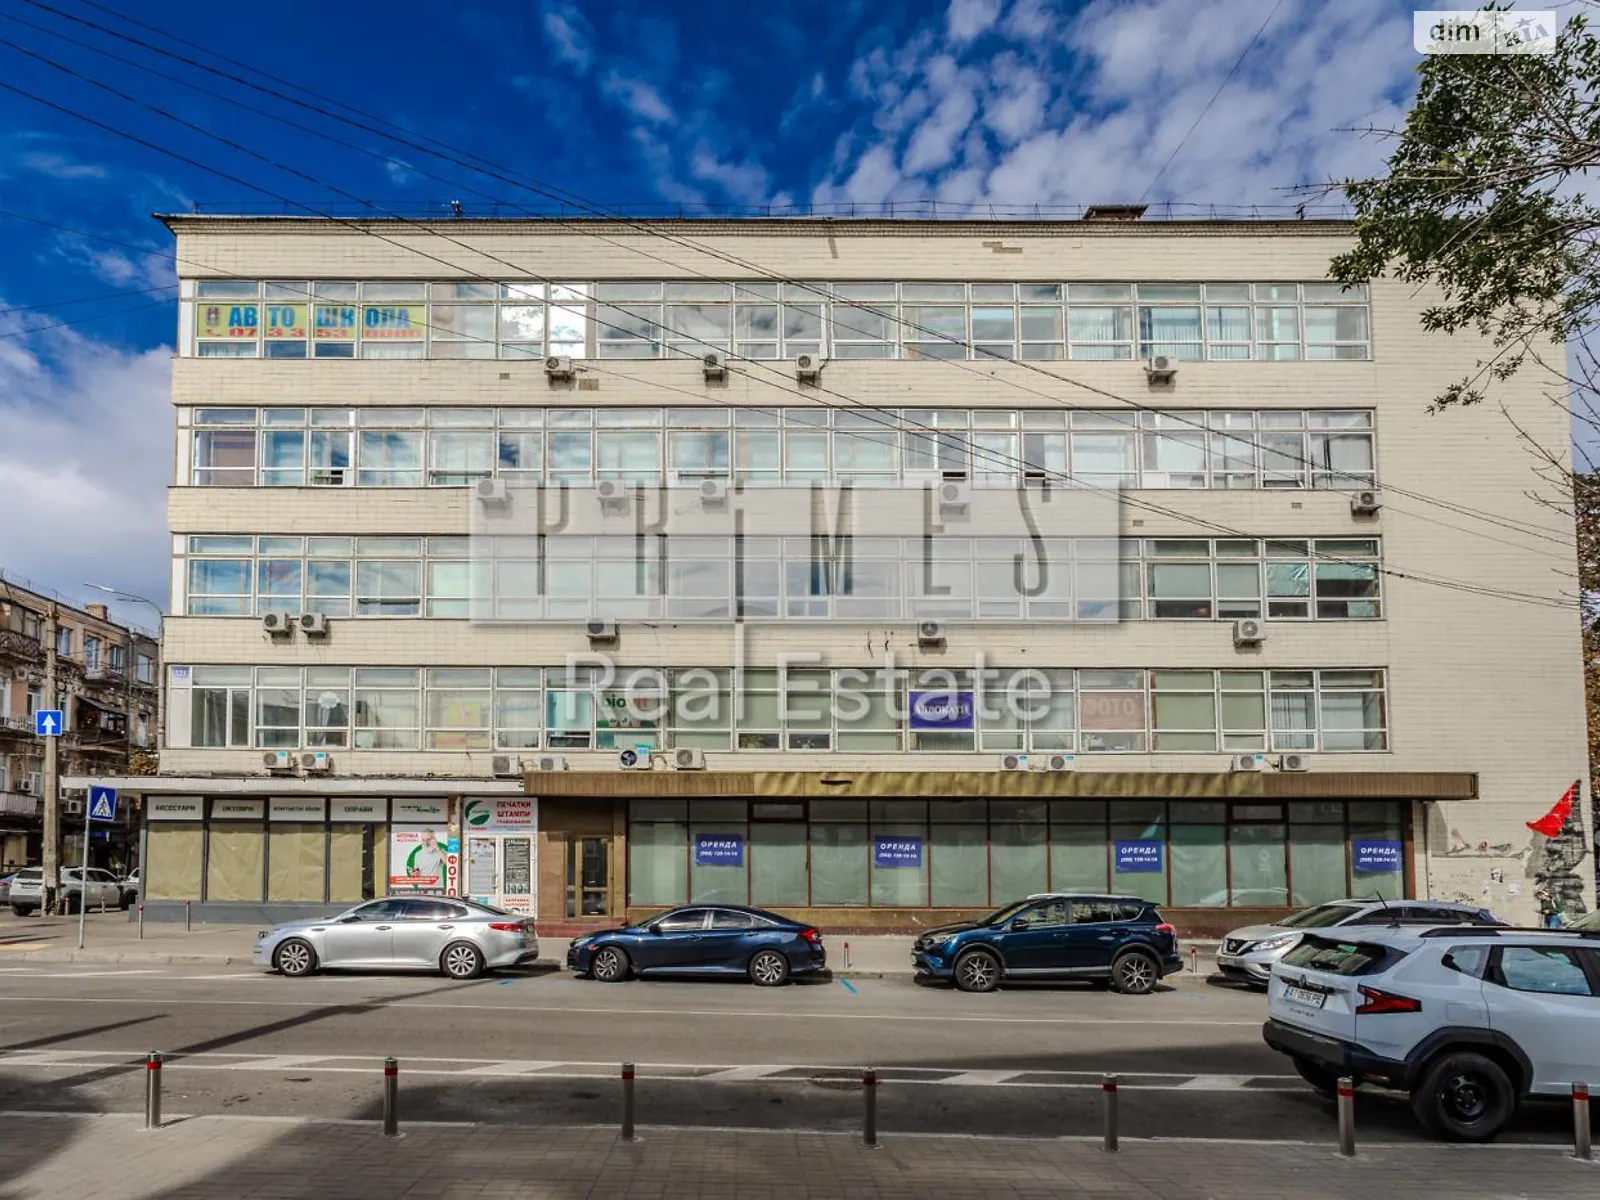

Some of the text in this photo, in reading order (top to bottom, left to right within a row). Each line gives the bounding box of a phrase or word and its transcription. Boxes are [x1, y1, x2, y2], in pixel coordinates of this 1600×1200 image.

[880, 843, 916, 851] ОРЕНДА
[1121, 847, 1157, 855] ОРЕНДА
[1360, 847, 1396, 855] ОРЕНДА
